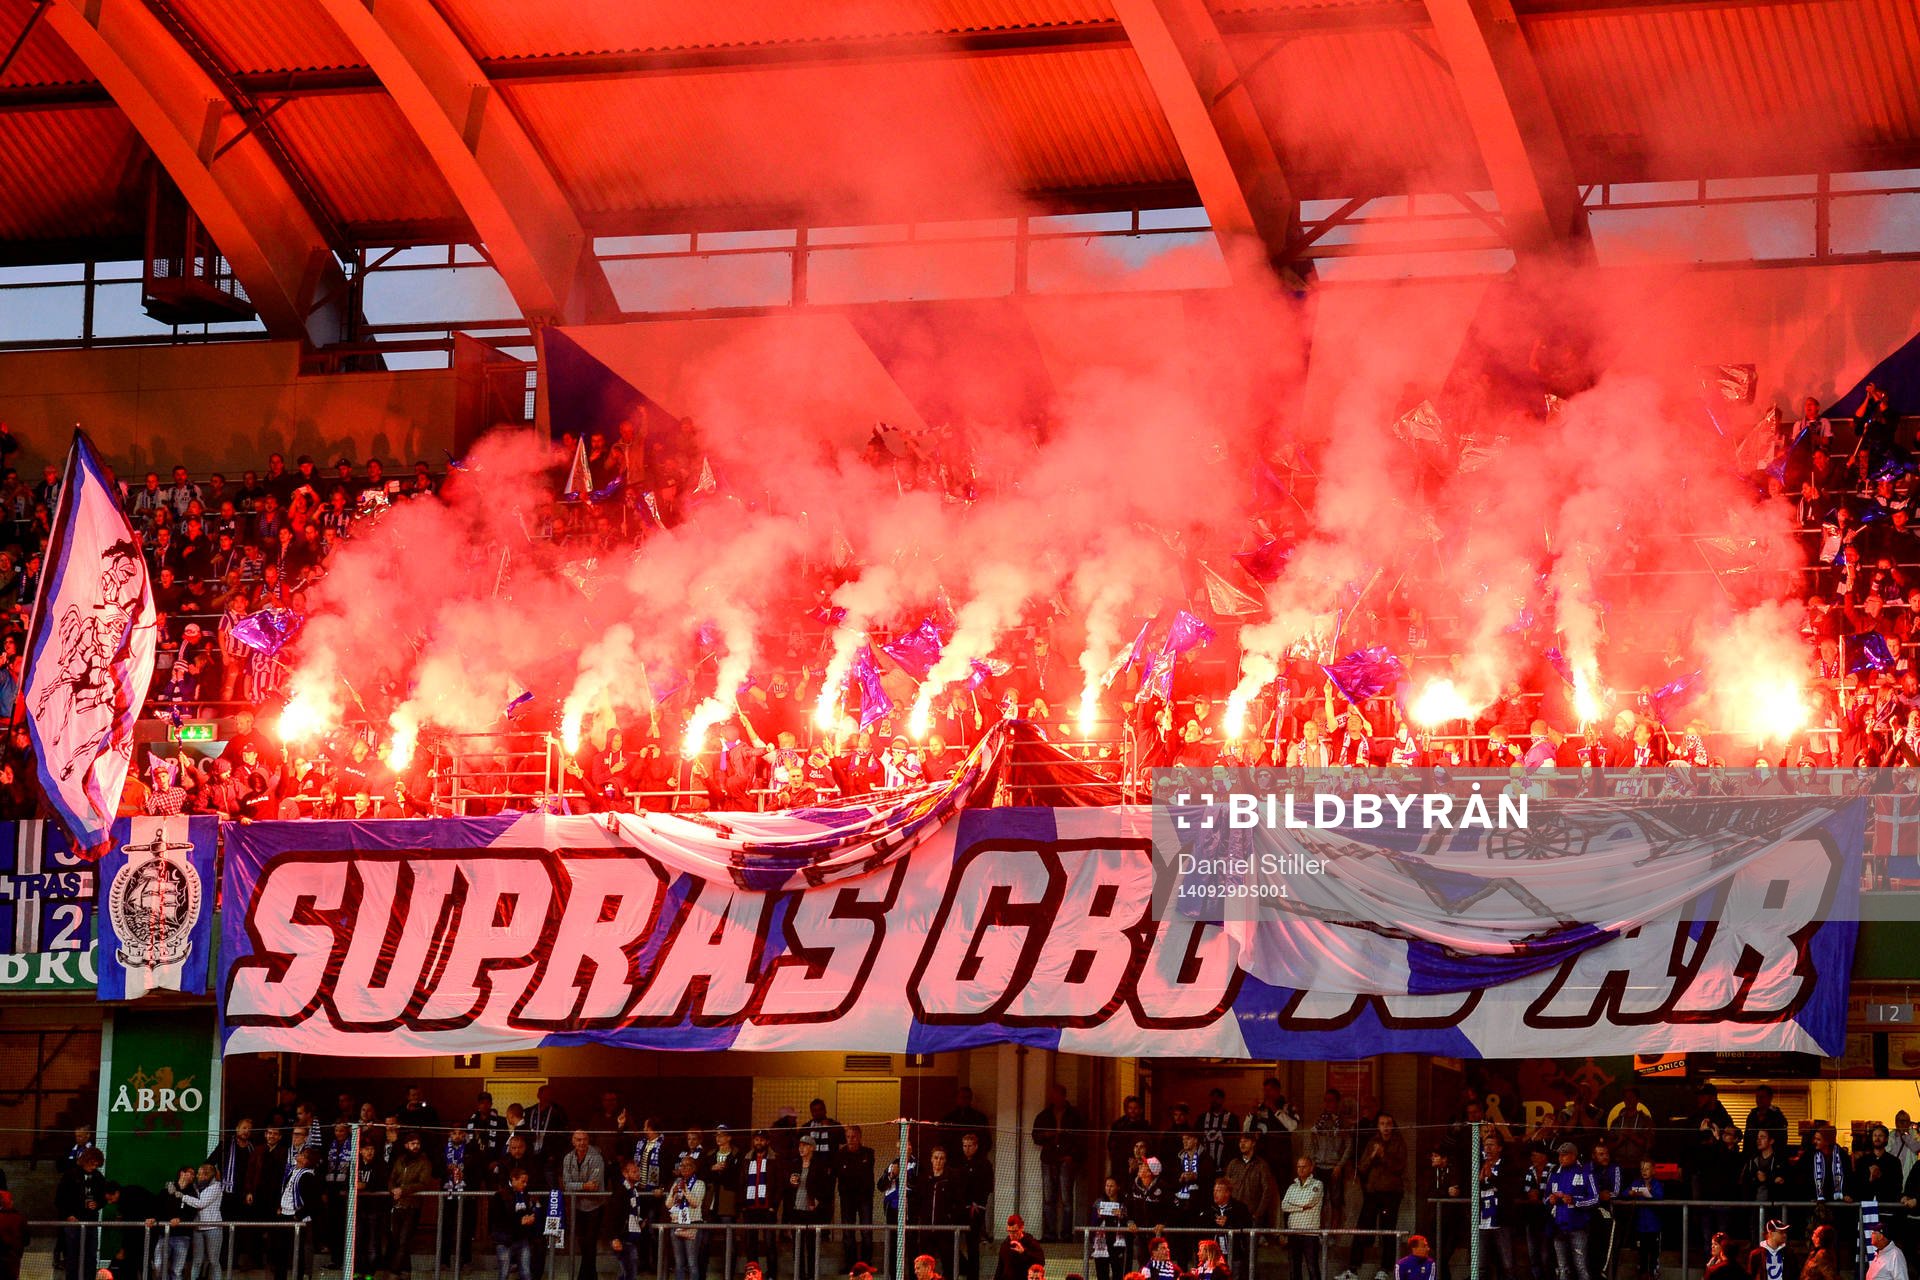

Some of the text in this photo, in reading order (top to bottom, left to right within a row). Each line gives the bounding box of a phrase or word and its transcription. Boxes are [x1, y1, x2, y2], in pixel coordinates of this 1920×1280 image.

[0, 872, 81, 899] TRAS
[50, 904, 83, 950] 2
[225, 848, 911, 1033] SUPRAS
[1879, 1005, 1900, 1021] 12
[111, 1086, 202, 1112] ÅBRO
